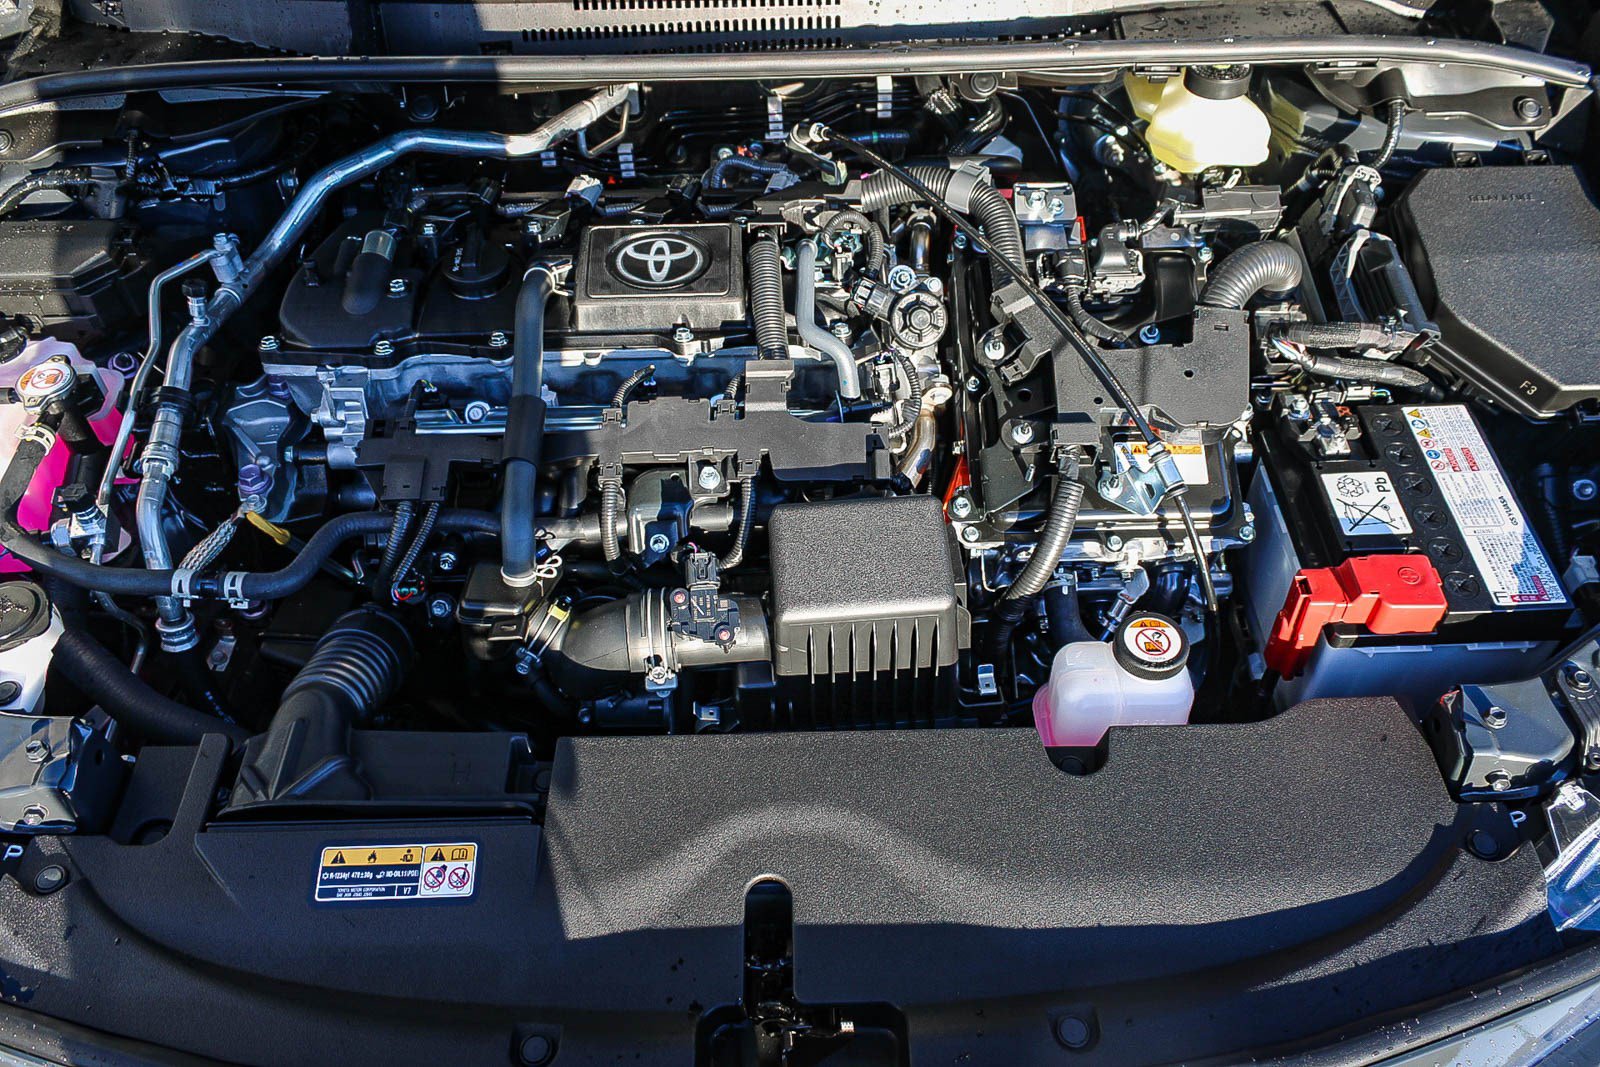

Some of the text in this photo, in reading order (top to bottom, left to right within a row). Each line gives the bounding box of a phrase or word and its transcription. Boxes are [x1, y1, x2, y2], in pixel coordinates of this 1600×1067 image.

[1520, 381, 1537, 395] F3
[1375, 477, 1391, 493] Pb
[1498, 495, 1514, 516] YUASA
[1509, 516, 1518, 526] GS
[403, 887, 412, 895] V7
